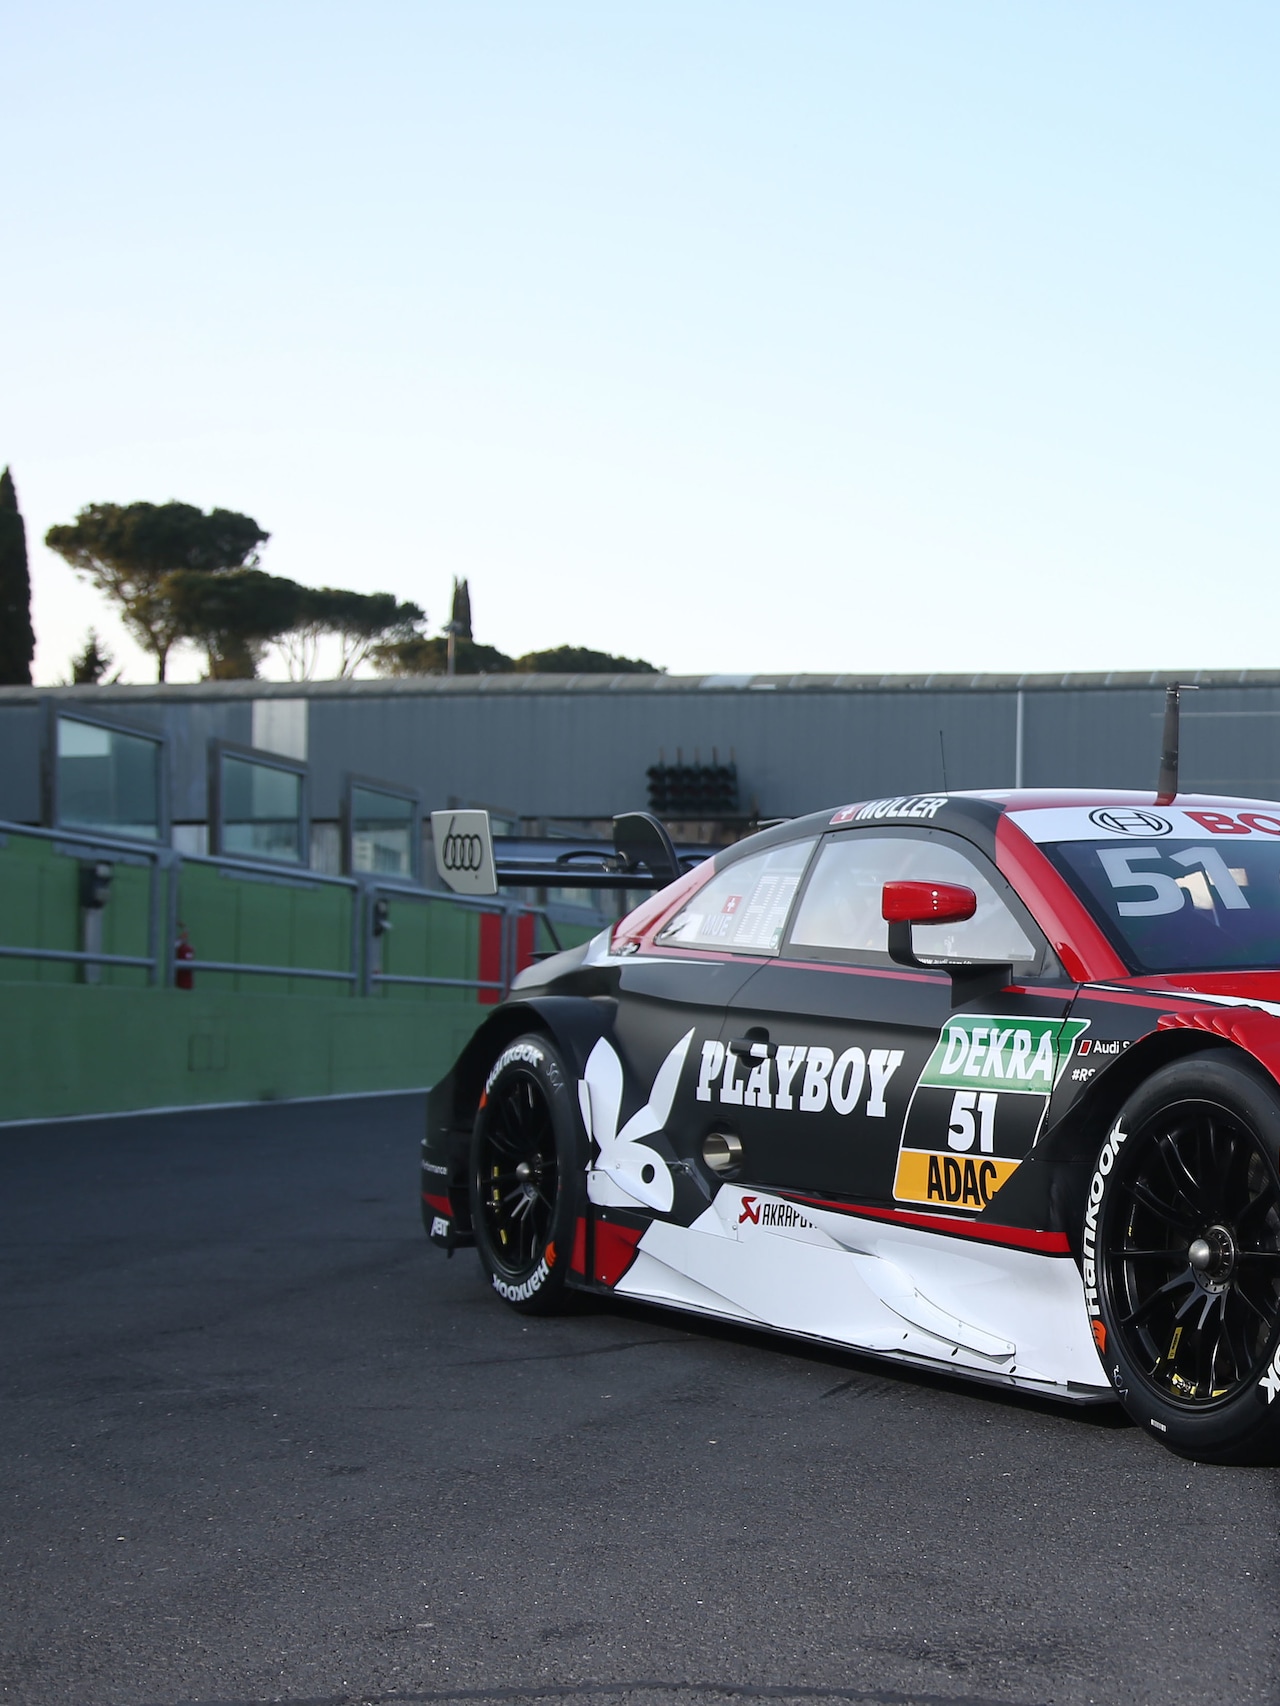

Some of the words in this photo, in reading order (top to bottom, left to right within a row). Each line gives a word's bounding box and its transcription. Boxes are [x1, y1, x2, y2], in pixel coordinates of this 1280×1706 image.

[1096, 845, 1251, 918] 51
[939, 1025, 1053, 1082] DEKRA
[1093, 1040, 1120, 1054] Audi
[695, 1039, 905, 1118] PLAYBOY
[947, 1090, 999, 1154] 51
[926, 1154, 999, 1206] ADAC
[430, 1215, 450, 1238] ABT
